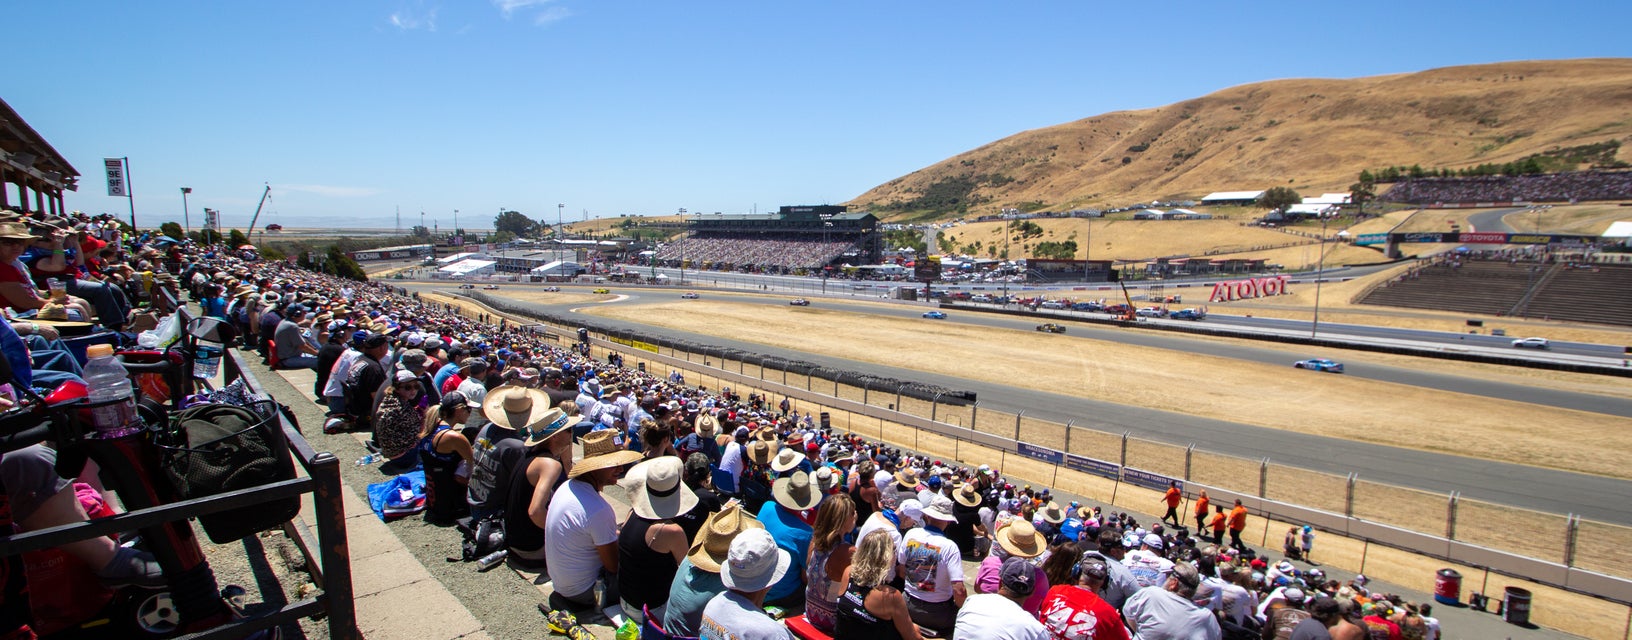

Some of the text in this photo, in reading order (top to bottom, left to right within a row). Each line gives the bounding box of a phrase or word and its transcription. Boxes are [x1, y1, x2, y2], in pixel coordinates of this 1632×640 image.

[108, 170, 121, 178] 9E
[109, 179, 122, 187] 9F
[354, 252, 381, 260] YOKOHAMA
[1151, 475, 1167, 484] TICKETS
